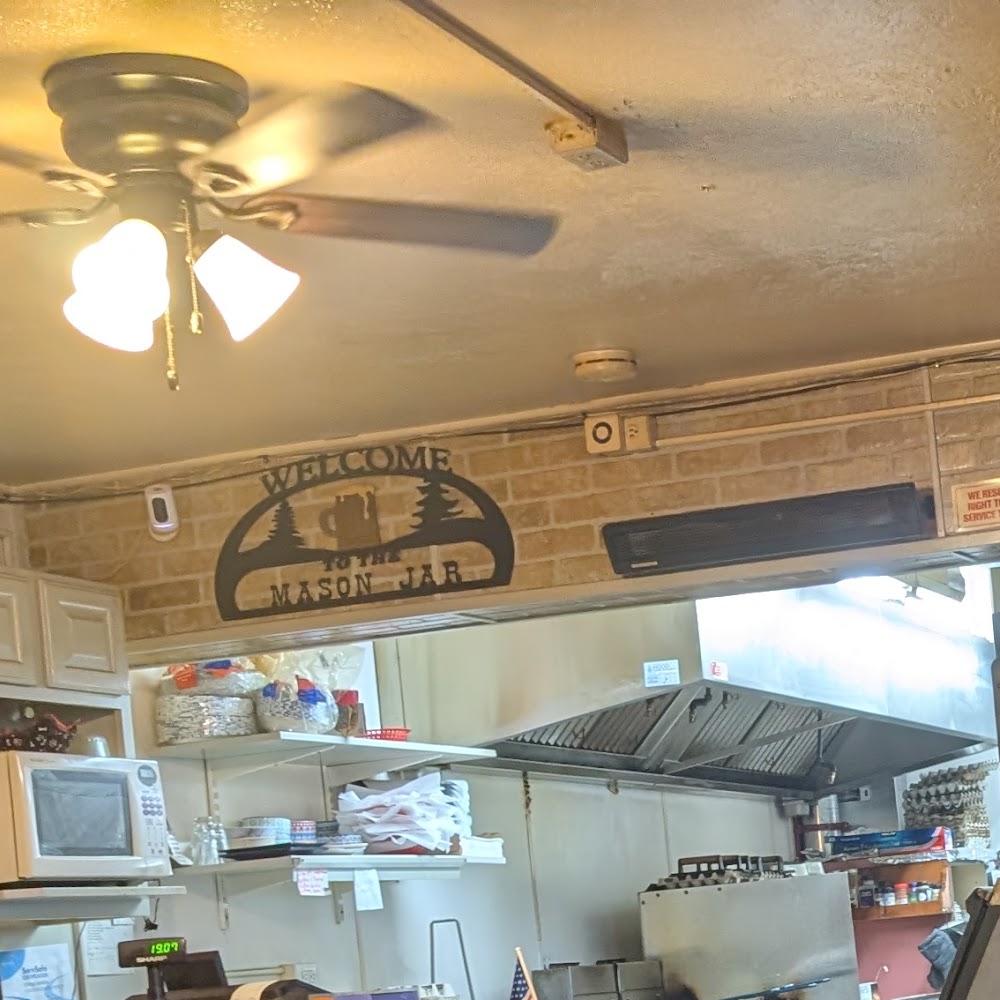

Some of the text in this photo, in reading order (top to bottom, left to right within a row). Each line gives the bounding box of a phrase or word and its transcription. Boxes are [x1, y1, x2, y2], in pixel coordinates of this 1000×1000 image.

[260, 445, 453, 496] WELCOME
[967, 490, 981, 501] WE
[967, 499, 992, 511] RIGHT
[963, 510, 997, 522] SERVICE
[270, 560, 463, 606] MASON JAR
